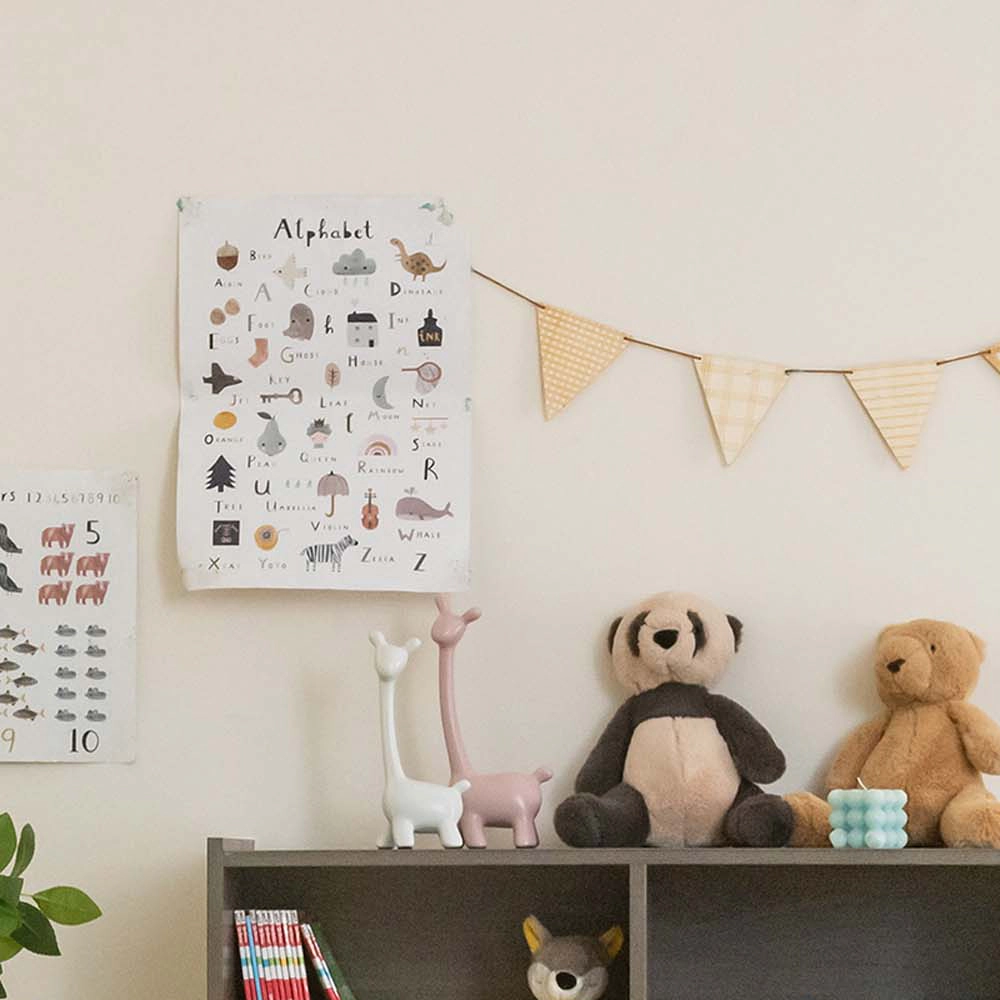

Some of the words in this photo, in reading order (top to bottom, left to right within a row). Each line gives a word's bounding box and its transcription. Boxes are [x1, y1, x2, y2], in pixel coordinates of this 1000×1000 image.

[273, 217, 375, 248] Alphabet
[254, 283, 272, 302] A
[323, 314, 335, 335] h
[423, 456, 439, 481] R
[86, 519, 101, 545] 5
[413, 552, 428, 572] Z
[1, 727, 16, 752] 9
[69, 728, 100, 753] 10
